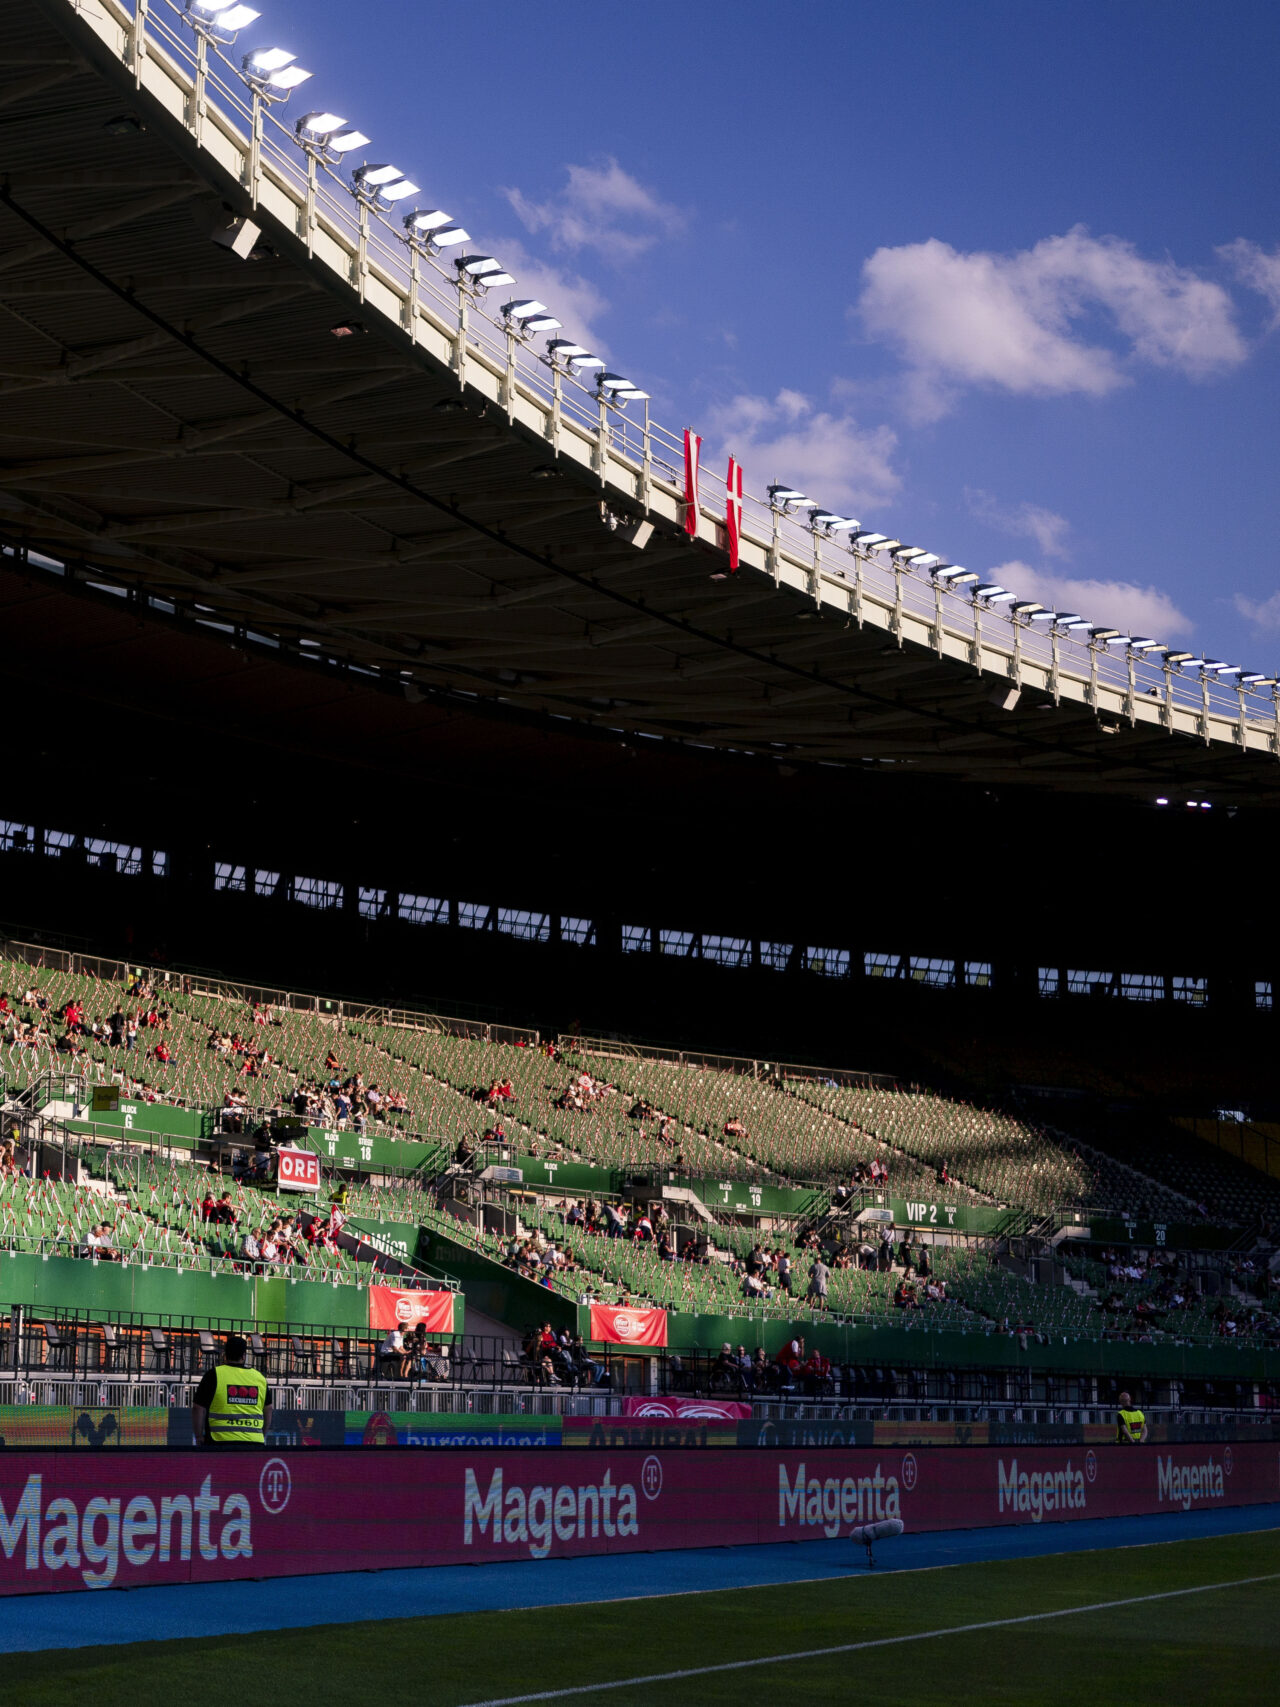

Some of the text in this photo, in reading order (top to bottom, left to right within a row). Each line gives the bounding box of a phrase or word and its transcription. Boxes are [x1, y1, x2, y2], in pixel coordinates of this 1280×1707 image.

[124, 1114, 133, 1129] G
[328, 1141, 336, 1156] H
[360, 1146, 372, 1161] 18
[281, 1156, 317, 1179] ORF
[723, 1190, 729, 1203] J
[751, 1193, 762, 1207] 19
[906, 1202, 927, 1222] VIP
[929, 1205, 938, 1224] 2
[948, 1213, 955, 1225] K
[998, 1458, 1086, 1523] Magenta
[1157, 1455, 1224, 1511] Magenta
[778, 1462, 901, 1538] Magenta
[464, 1467, 639, 1559] Magenta
